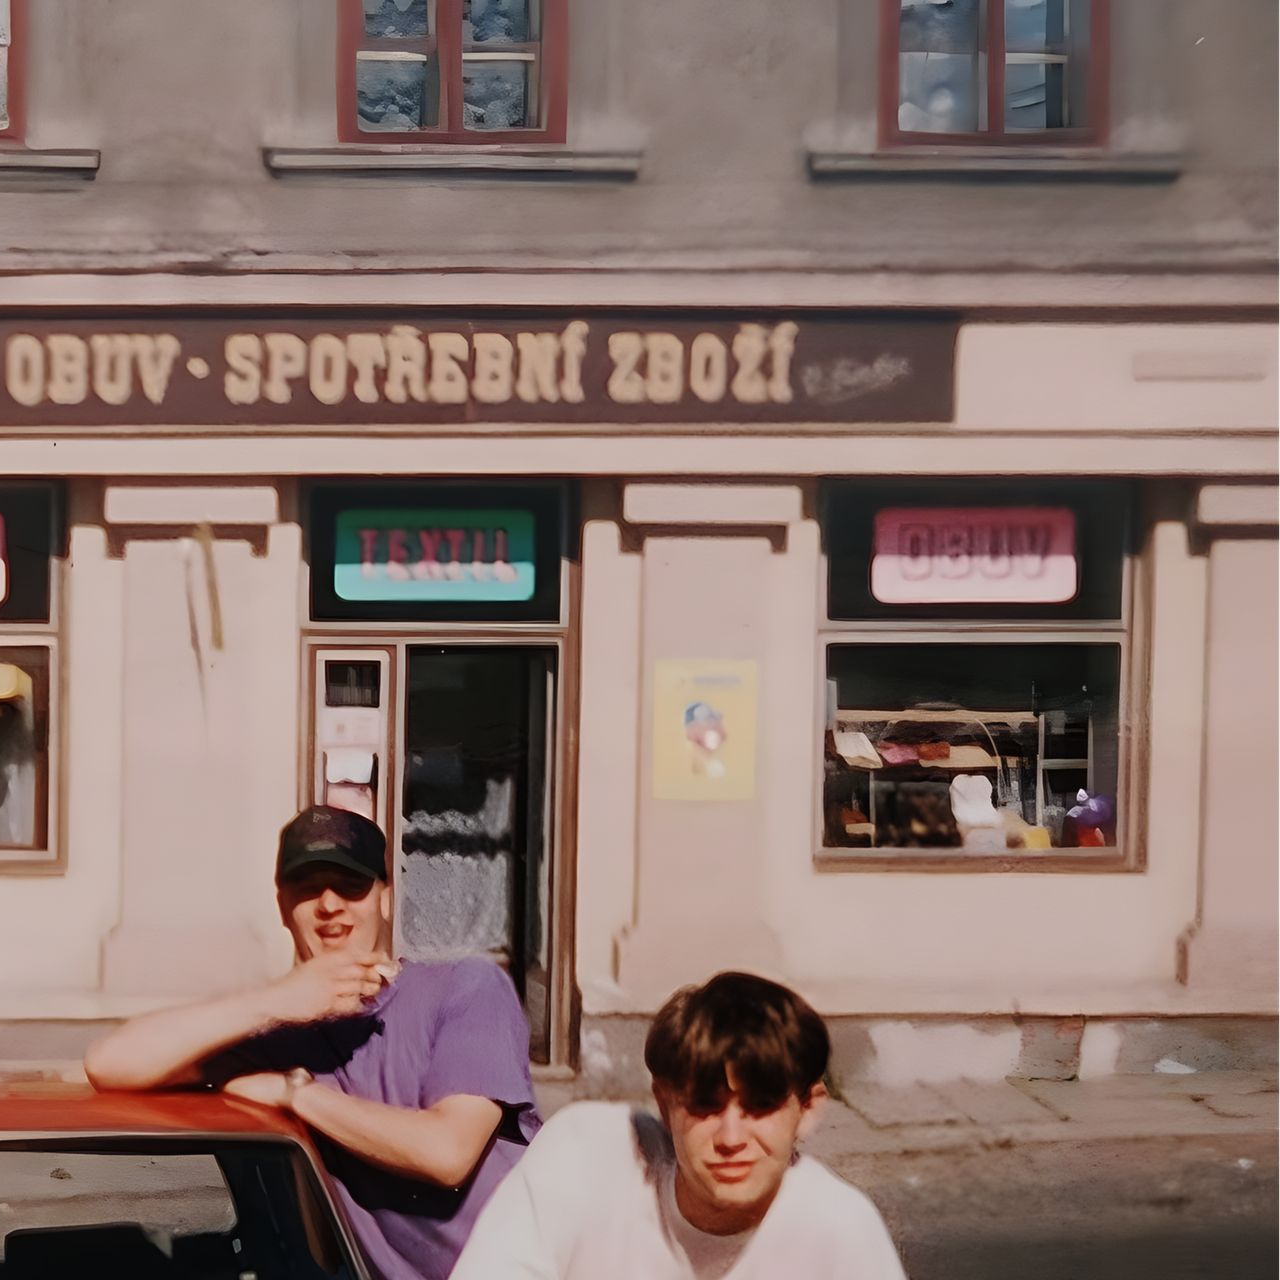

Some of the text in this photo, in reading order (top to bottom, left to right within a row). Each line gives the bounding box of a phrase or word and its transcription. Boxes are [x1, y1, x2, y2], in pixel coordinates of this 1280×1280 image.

[5, 331, 182, 406] OBUV
[223, 323, 590, 405] SPOTŘEBNÍ
[607, 319, 801, 404] ZBOŽÍ
[357, 526, 517, 583] TEXTIL
[897, 522, 1053, 582] OBUV
